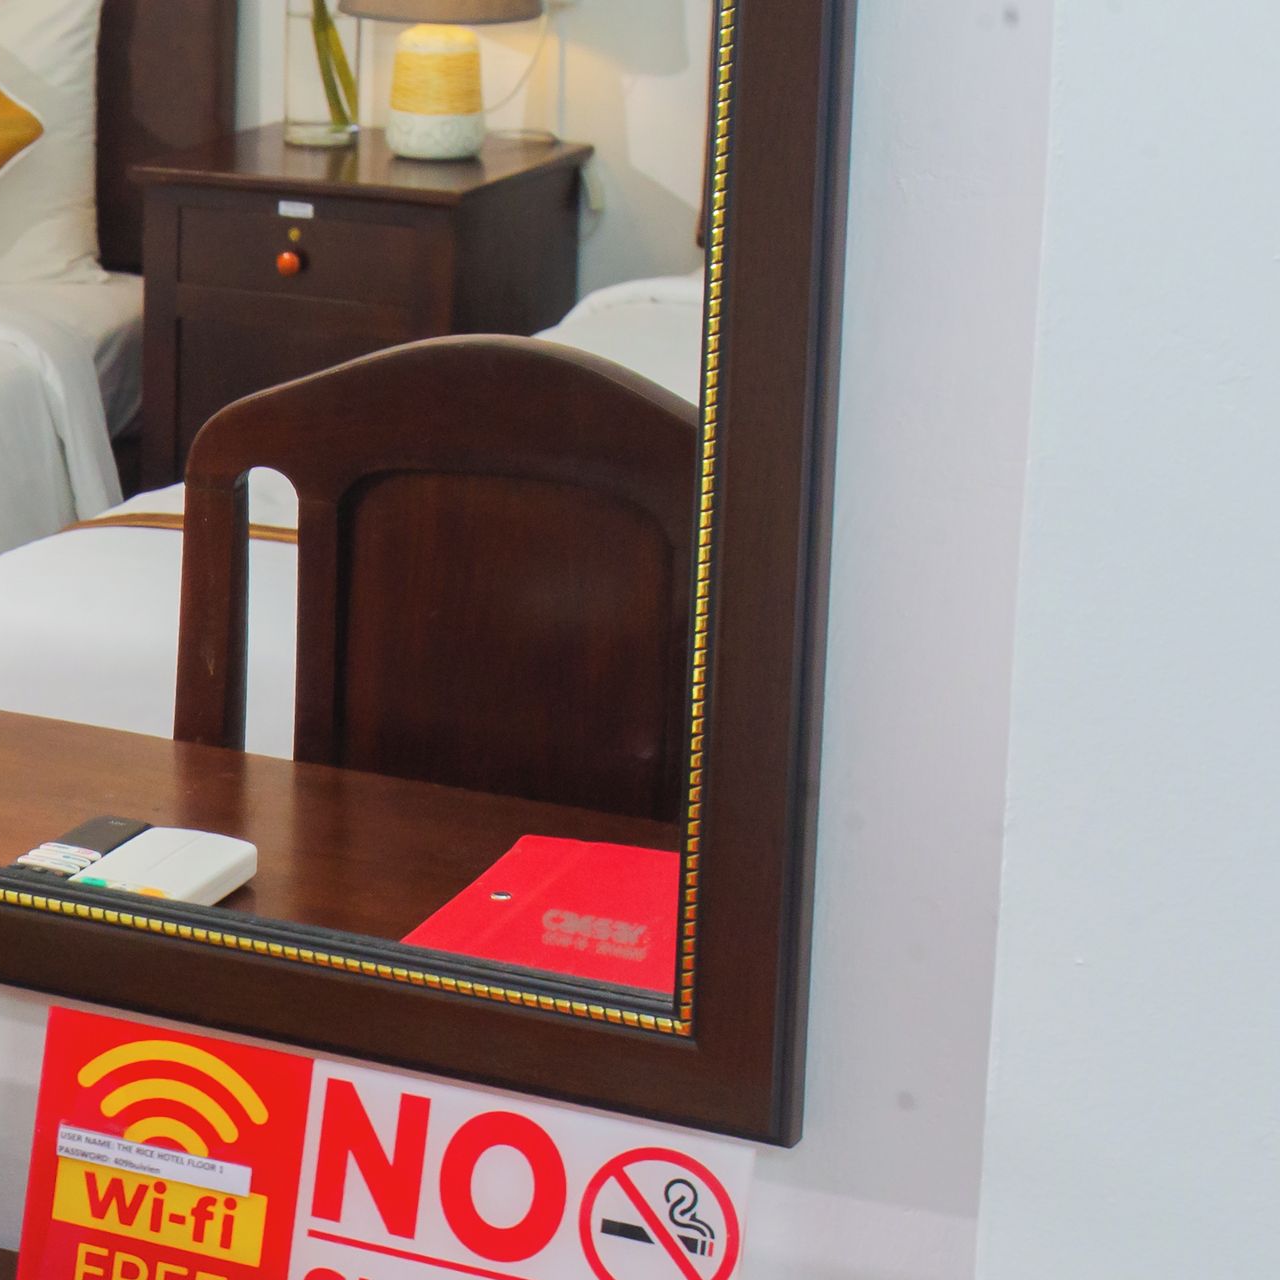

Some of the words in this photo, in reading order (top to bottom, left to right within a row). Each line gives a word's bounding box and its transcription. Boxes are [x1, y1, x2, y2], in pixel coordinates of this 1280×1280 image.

[58, 1145, 110, 1163] PASSWORD:
[60, 1131, 83, 1145] USER
[117, 1141, 133, 1154] THE
[135, 1144, 155, 1159] RICE
[156, 1151, 185, 1166] HOTEL
[187, 1158, 217, 1172] FLOOR
[309, 1078, 567, 1263] NO
[84, 1170, 238, 1250] Wi-fi
